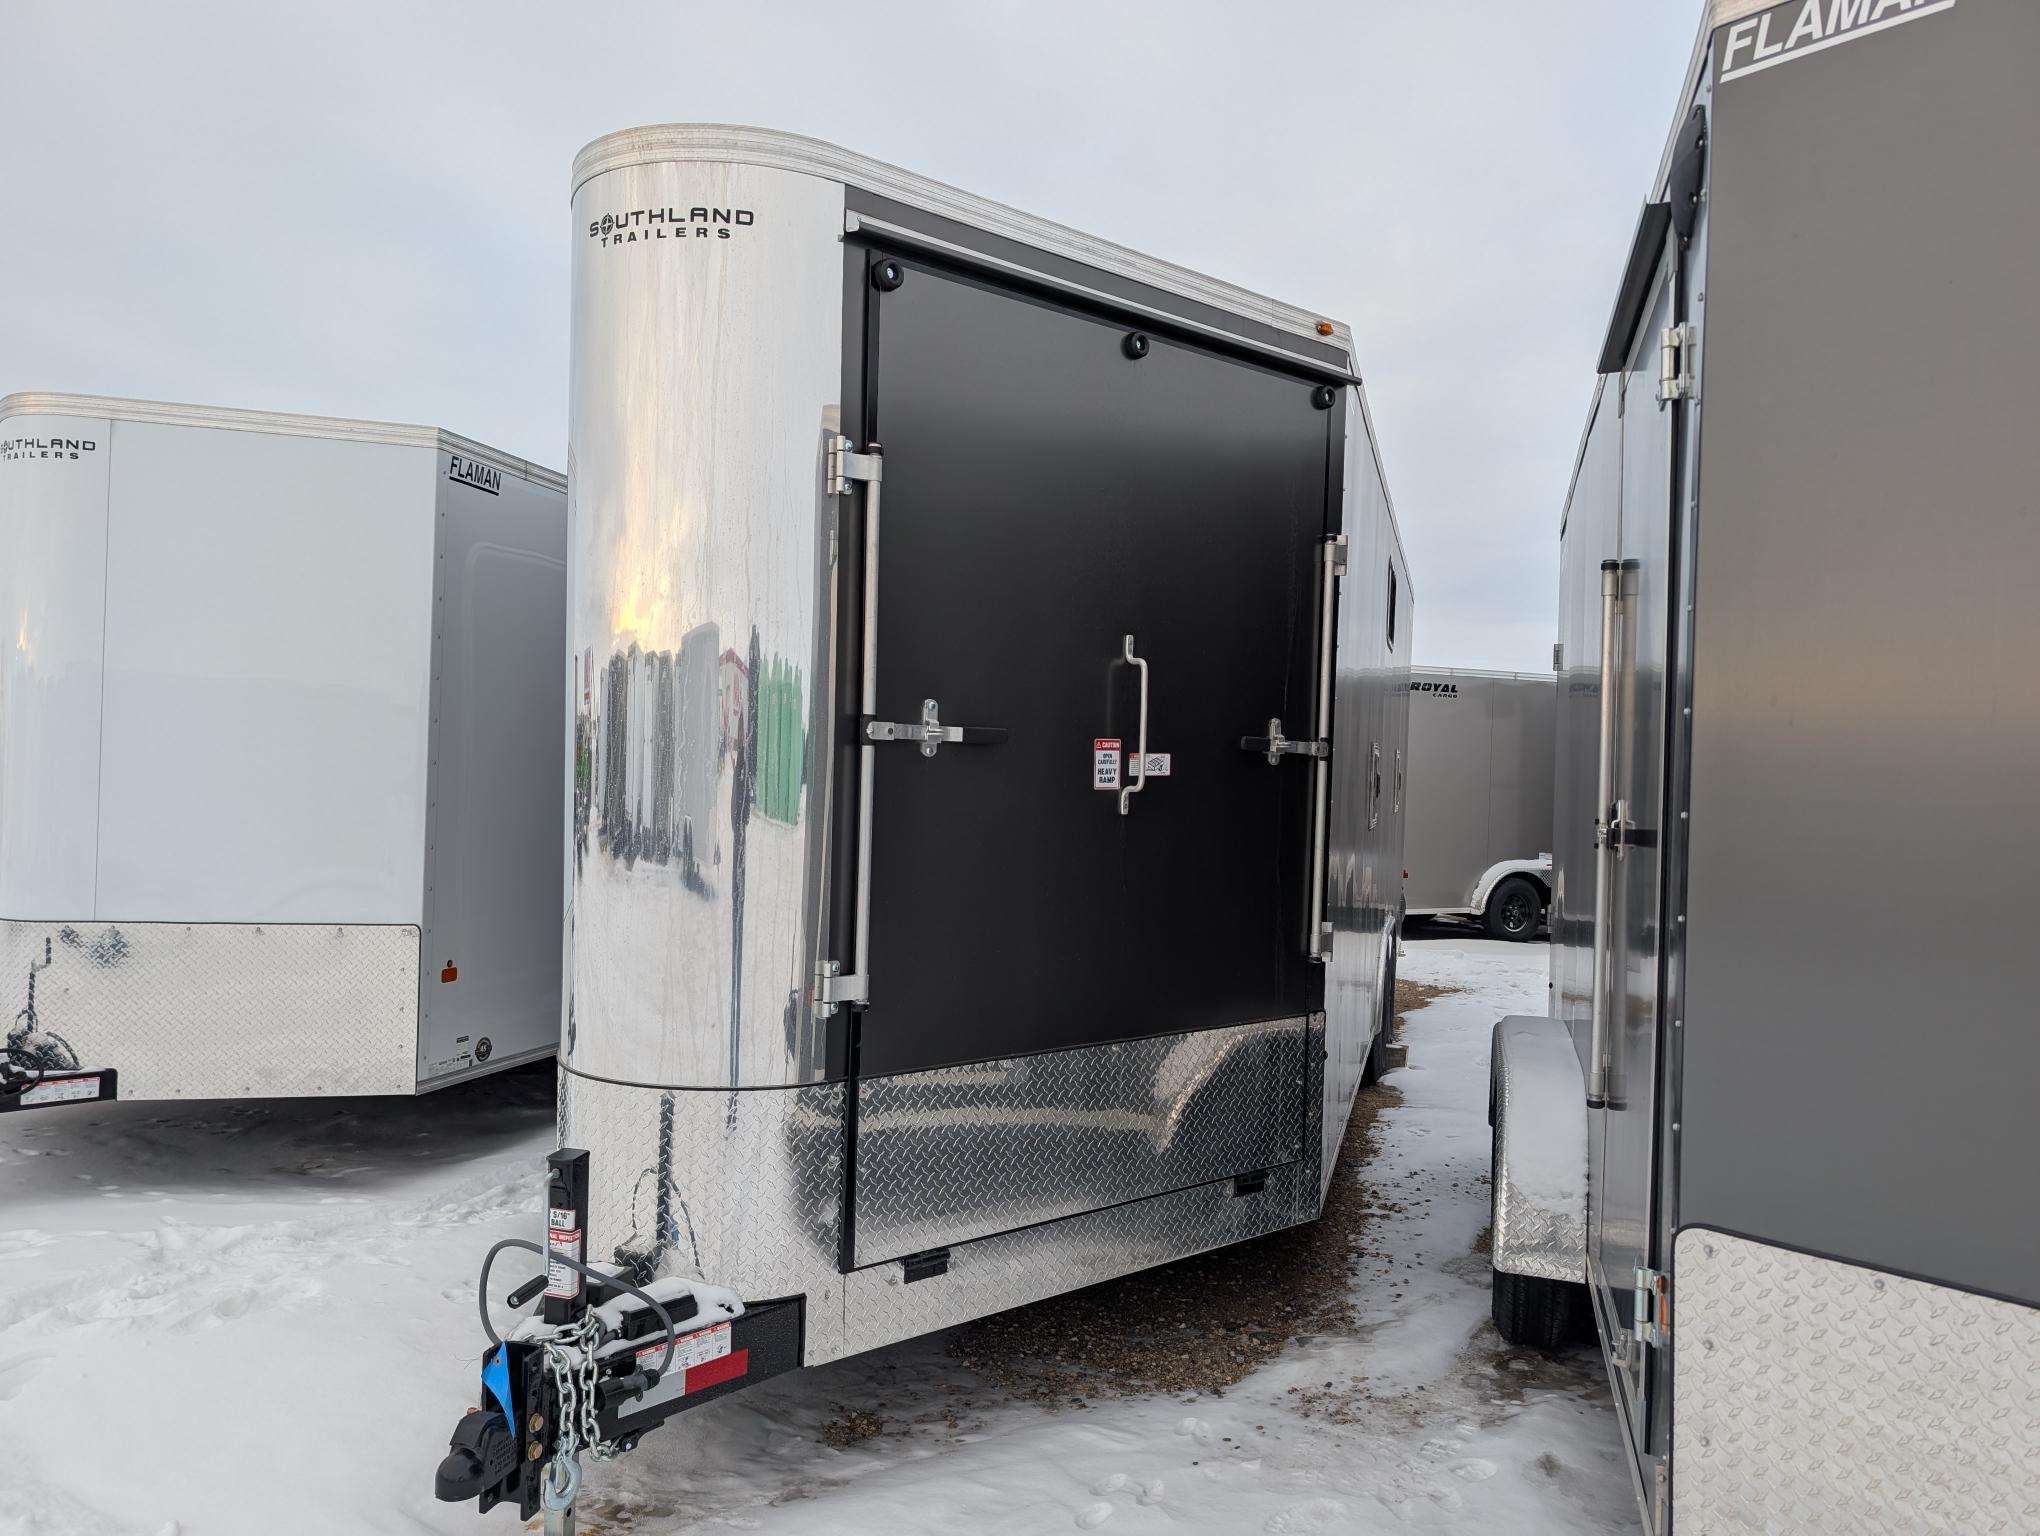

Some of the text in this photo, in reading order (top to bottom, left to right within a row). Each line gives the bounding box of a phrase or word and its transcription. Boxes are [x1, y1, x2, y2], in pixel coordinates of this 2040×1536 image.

[1722, 0, 1926, 71] FLAM
[589, 207, 754, 238] SOUTHLAND
[601, 227, 731, 248] TRAILERS
[3, 451, 79, 461] TRAILERS
[449, 455, 502, 491] FLAMAN
[1410, 681, 1458, 693] ROYAL
[1099, 776, 1116, 784] RAMP
[551, 1218, 566, 1228] BALL
